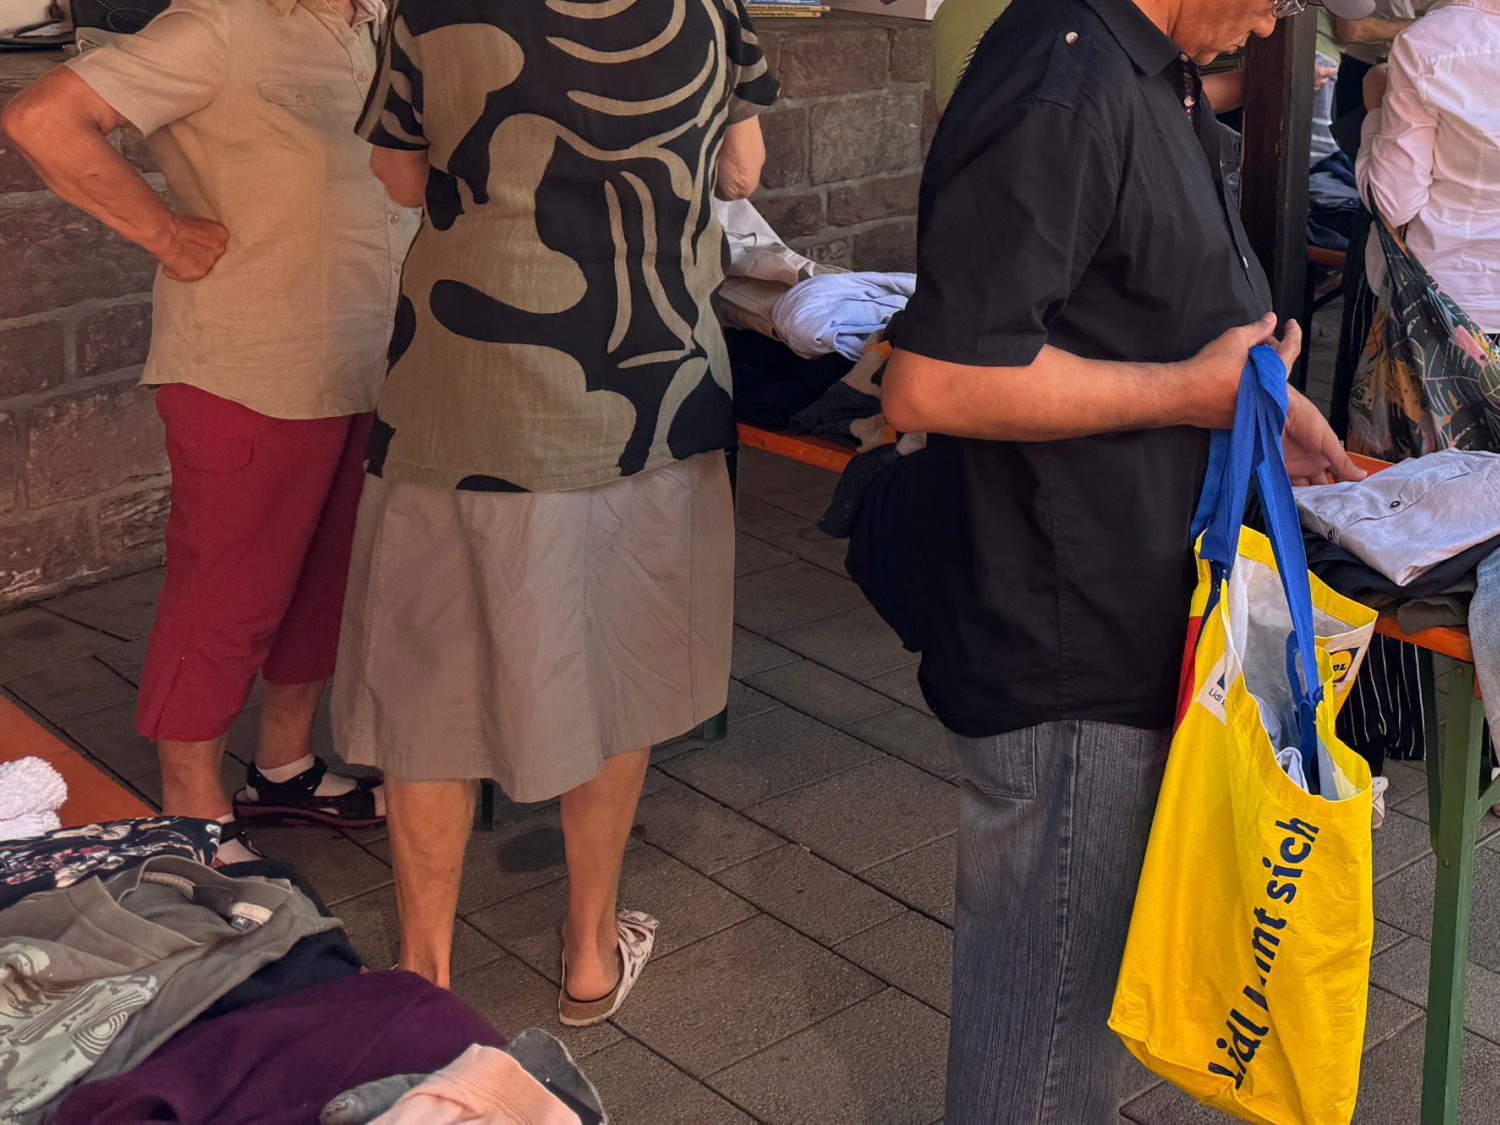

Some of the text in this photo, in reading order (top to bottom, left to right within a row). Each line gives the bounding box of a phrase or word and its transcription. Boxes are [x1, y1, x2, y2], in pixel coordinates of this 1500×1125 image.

[1208, 687, 1223, 702] Lidl
[1207, 1007, 1270, 1091] Lidl
[1261, 817, 1320, 905] sich
